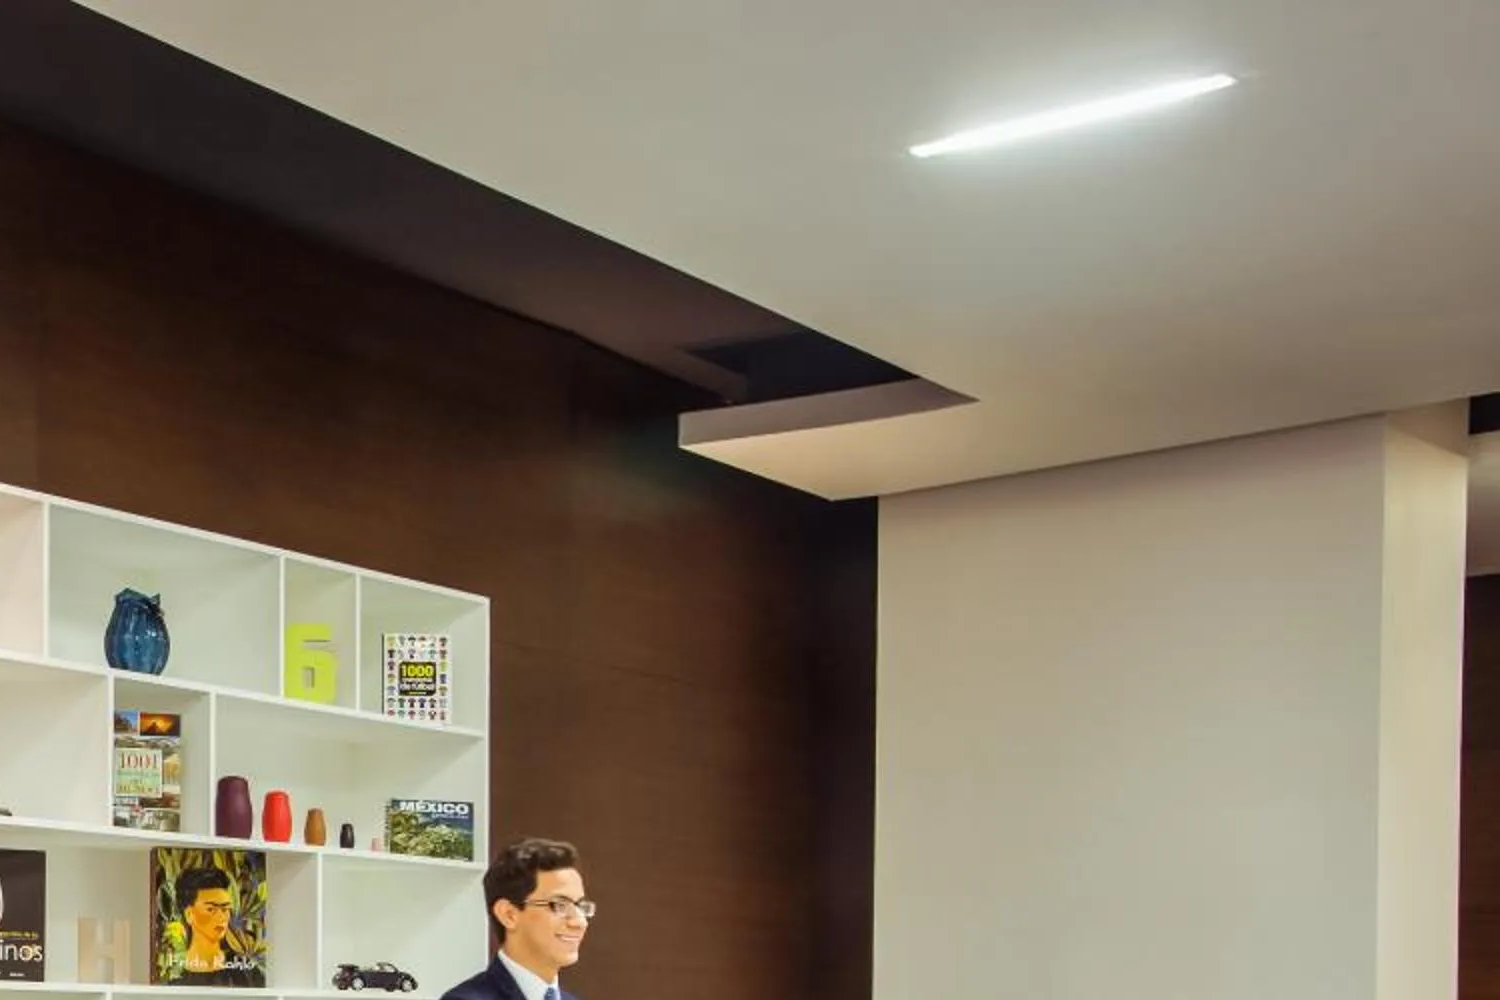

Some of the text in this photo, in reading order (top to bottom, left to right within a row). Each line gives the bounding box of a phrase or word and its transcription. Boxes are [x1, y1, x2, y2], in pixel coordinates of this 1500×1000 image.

[285, 623, 336, 704] 6
[401, 664, 434, 677] 1000
[121, 752, 157, 769] 1001
[399, 800, 469, 814] MÉXICO
[78, 918, 130, 984] H
[212, 954, 256, 971] Kahlo
